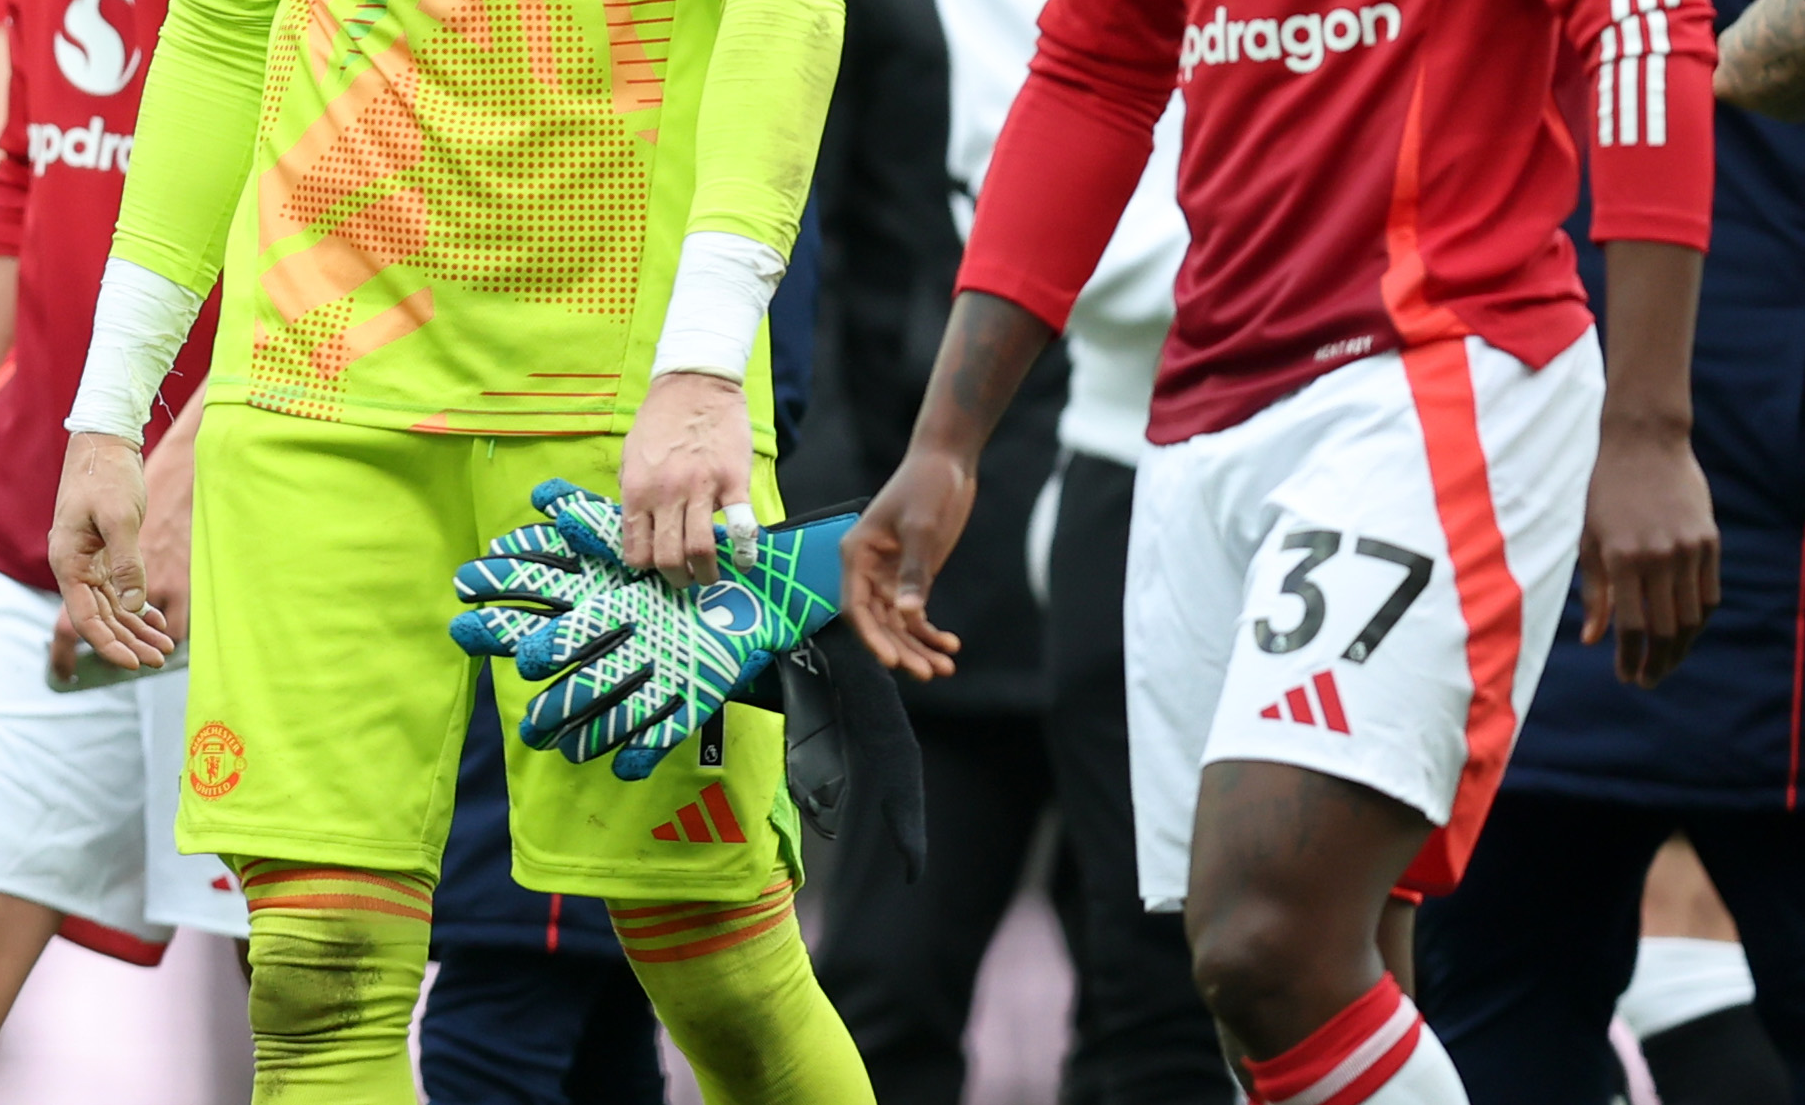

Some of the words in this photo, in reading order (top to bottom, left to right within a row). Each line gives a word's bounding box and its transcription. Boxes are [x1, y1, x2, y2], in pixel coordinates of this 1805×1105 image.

[1178, 2, 1402, 82] pdragon
[1254, 530, 1434, 664] 37
[196, 782, 231, 796] UNITED
